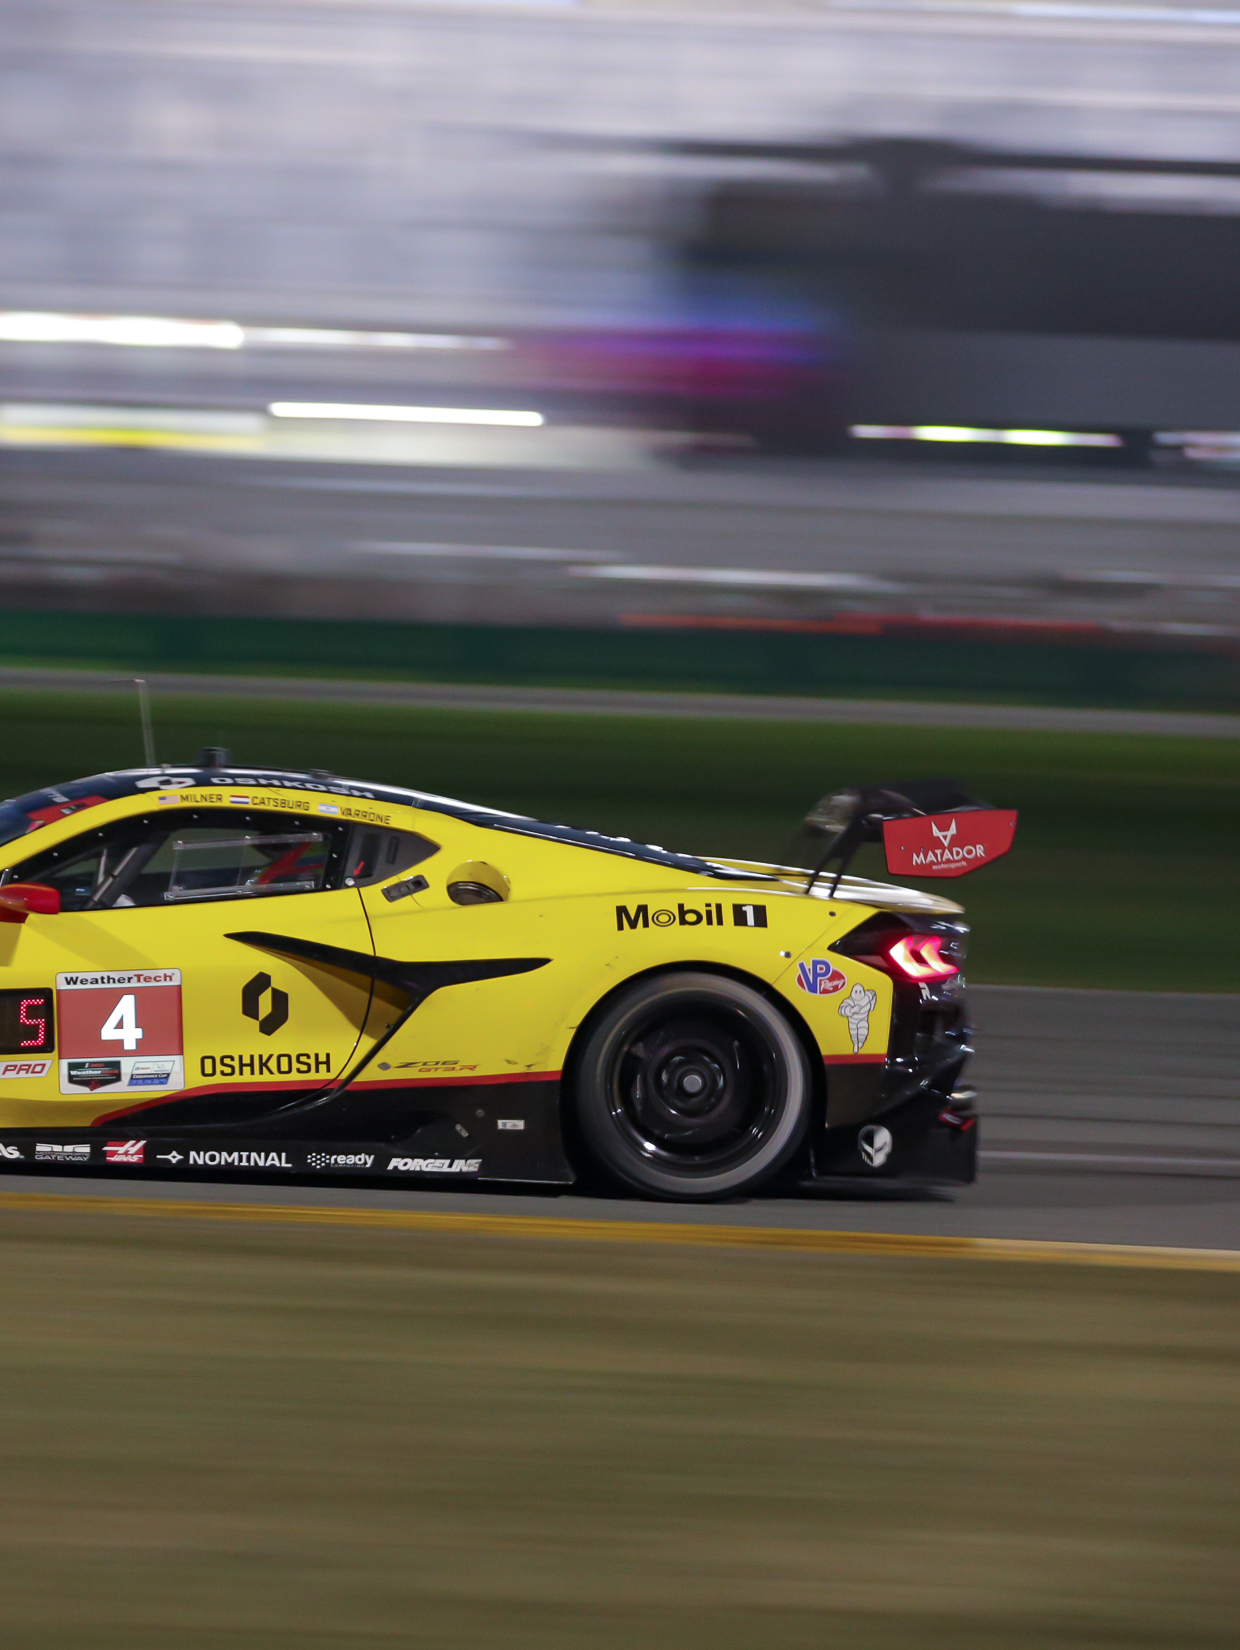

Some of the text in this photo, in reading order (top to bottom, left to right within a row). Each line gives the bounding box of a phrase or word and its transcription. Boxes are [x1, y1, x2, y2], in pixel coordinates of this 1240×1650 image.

[210, 776, 375, 799] OSHKOSH
[179, 793, 223, 804] MILNER
[251, 795, 310, 811] CATSBURG
[340, 806, 392, 825] VARRONE
[912, 844, 986, 866] MATADOR
[615, 902, 724, 932] Mobil
[64, 972, 173, 986] WeatherTech
[797, 958, 833, 995] VP
[19, 998, 46, 1047] 5
[100, 993, 144, 1051] 4
[1, 1063, 47, 1076] PRO
[200, 1052, 332, 1078] OSHKOSH
[34, 1154, 89, 1162] GATEWAY
[189, 1150, 293, 1167] NOMINAL
[330, 1152, 375, 1168] ready
[387, 1157, 483, 1173] FORGELINE
